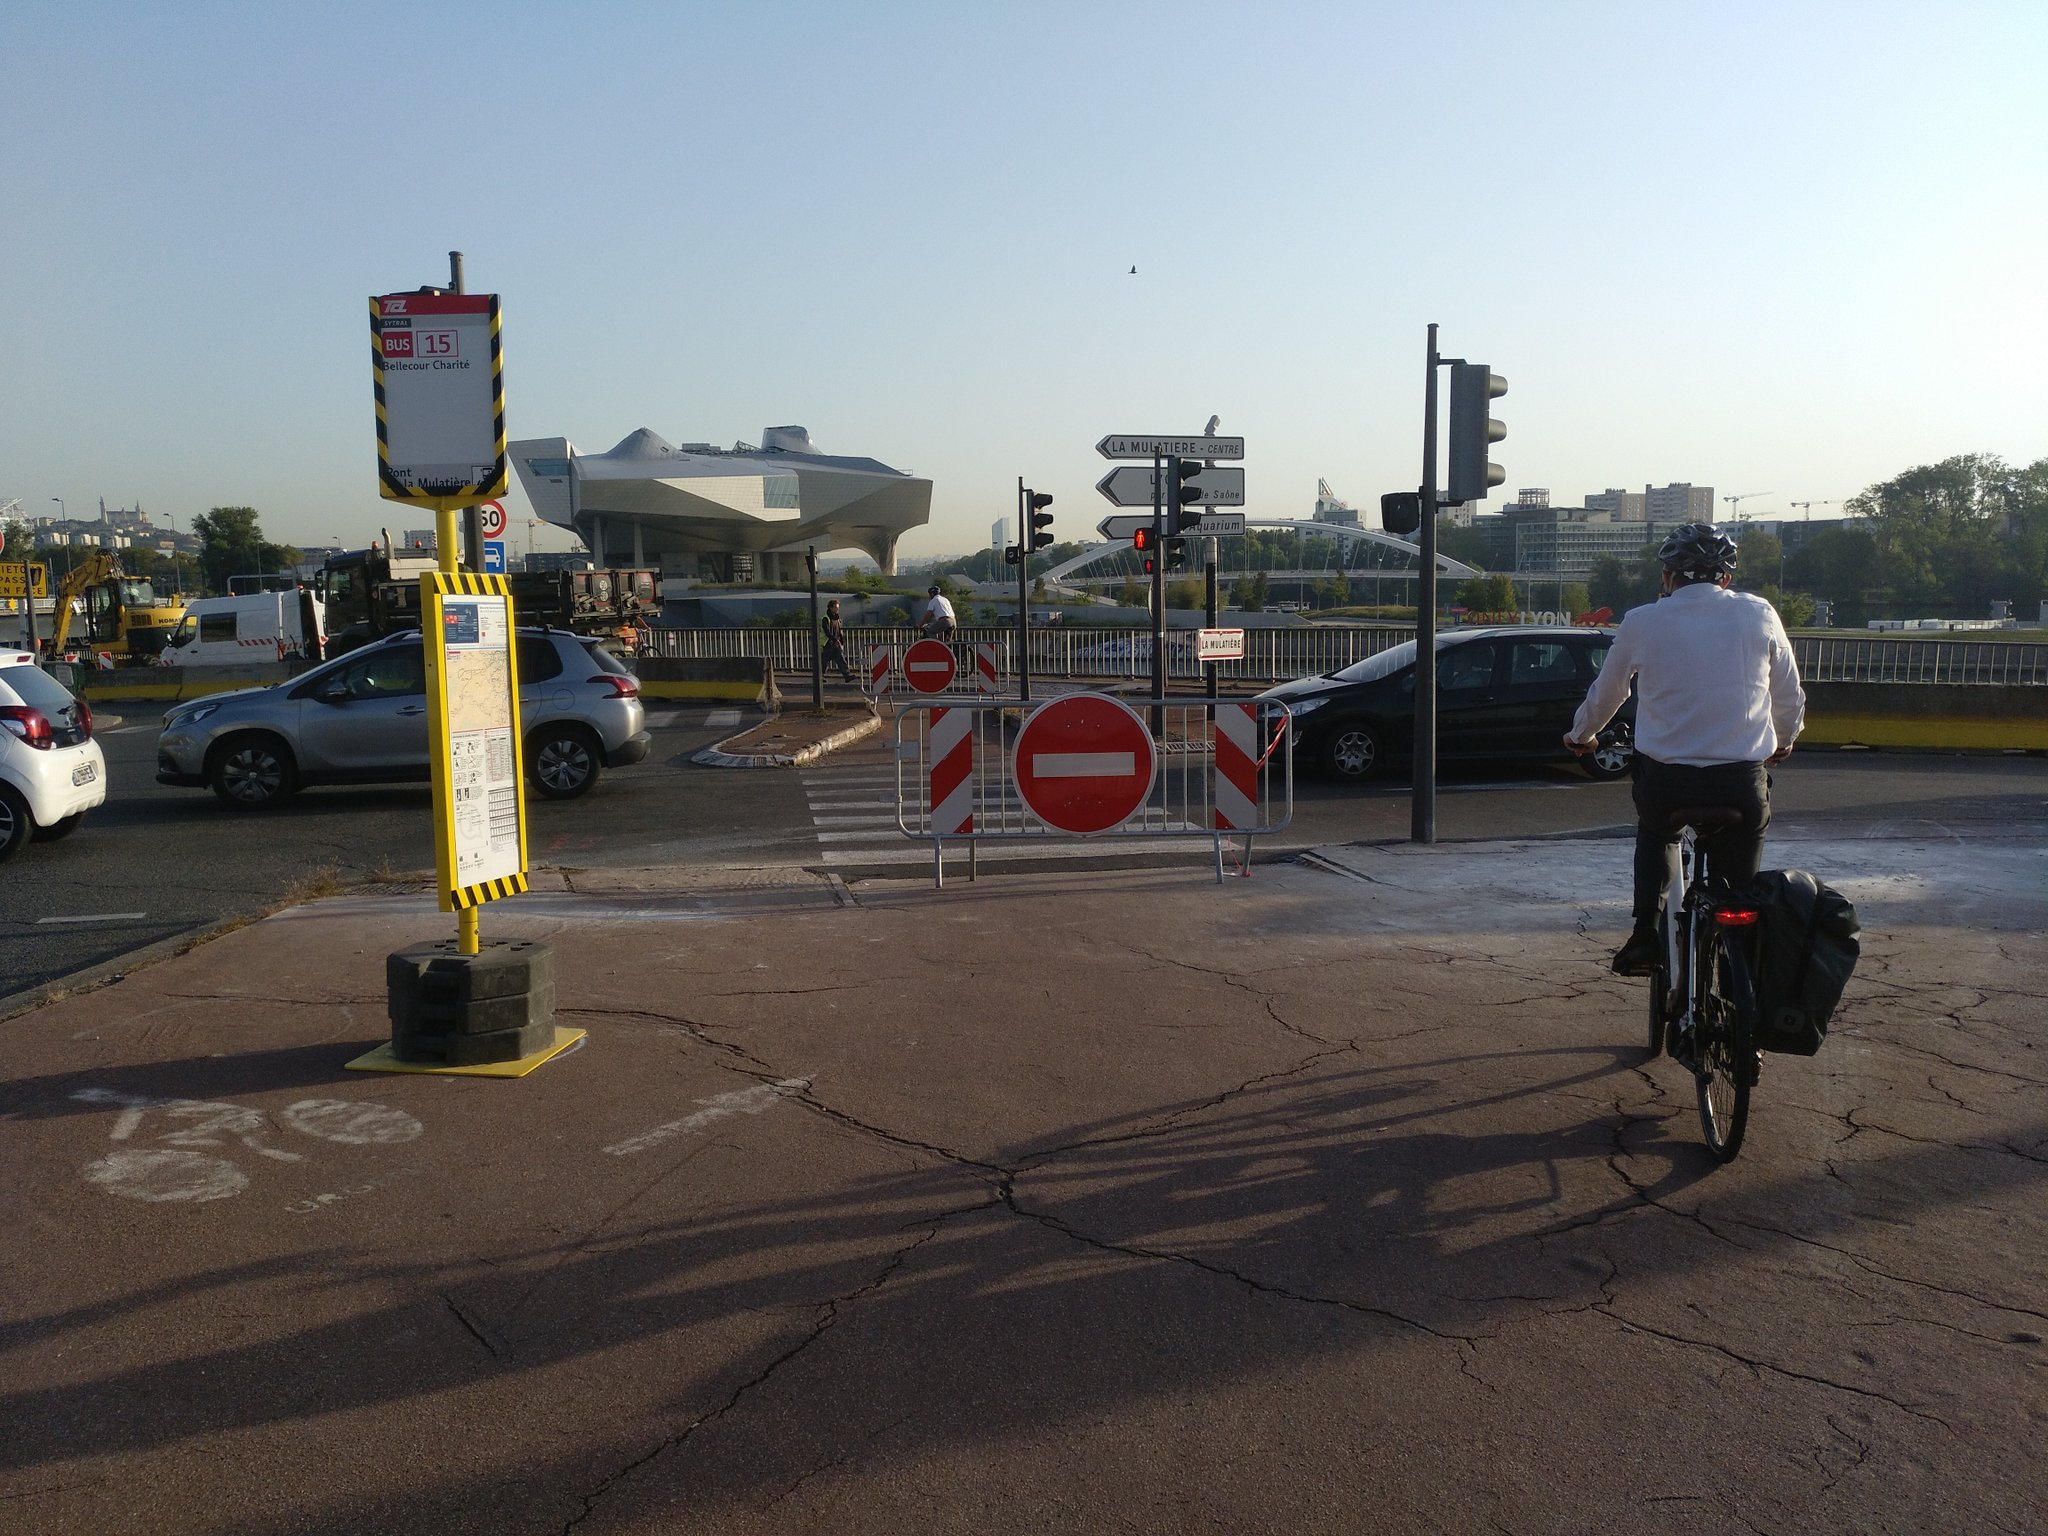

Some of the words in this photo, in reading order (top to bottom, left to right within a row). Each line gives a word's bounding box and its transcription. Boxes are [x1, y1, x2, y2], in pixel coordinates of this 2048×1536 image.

[386, 339, 410, 351] BUS
[425, 334, 451, 354] 15
[383, 361, 430, 371] Bellecour
[433, 359, 470, 370] Charité
[1112, 441, 1126, 453] LA
[1207, 444, 1239, 454] CENTRE
[418, 477, 471, 488] Mulatière
[1150, 490, 1166, 501] pr
[1213, 489, 1240, 499] Saône
[481, 510, 500, 527] 50
[0, 565, 27, 574] IETO
[0, 576, 26, 584] PASS
[1520, 611, 1572, 627] LYON
[1202, 640, 1209, 650] LA
[1210, 638, 1241, 649] MULATIÈRE
